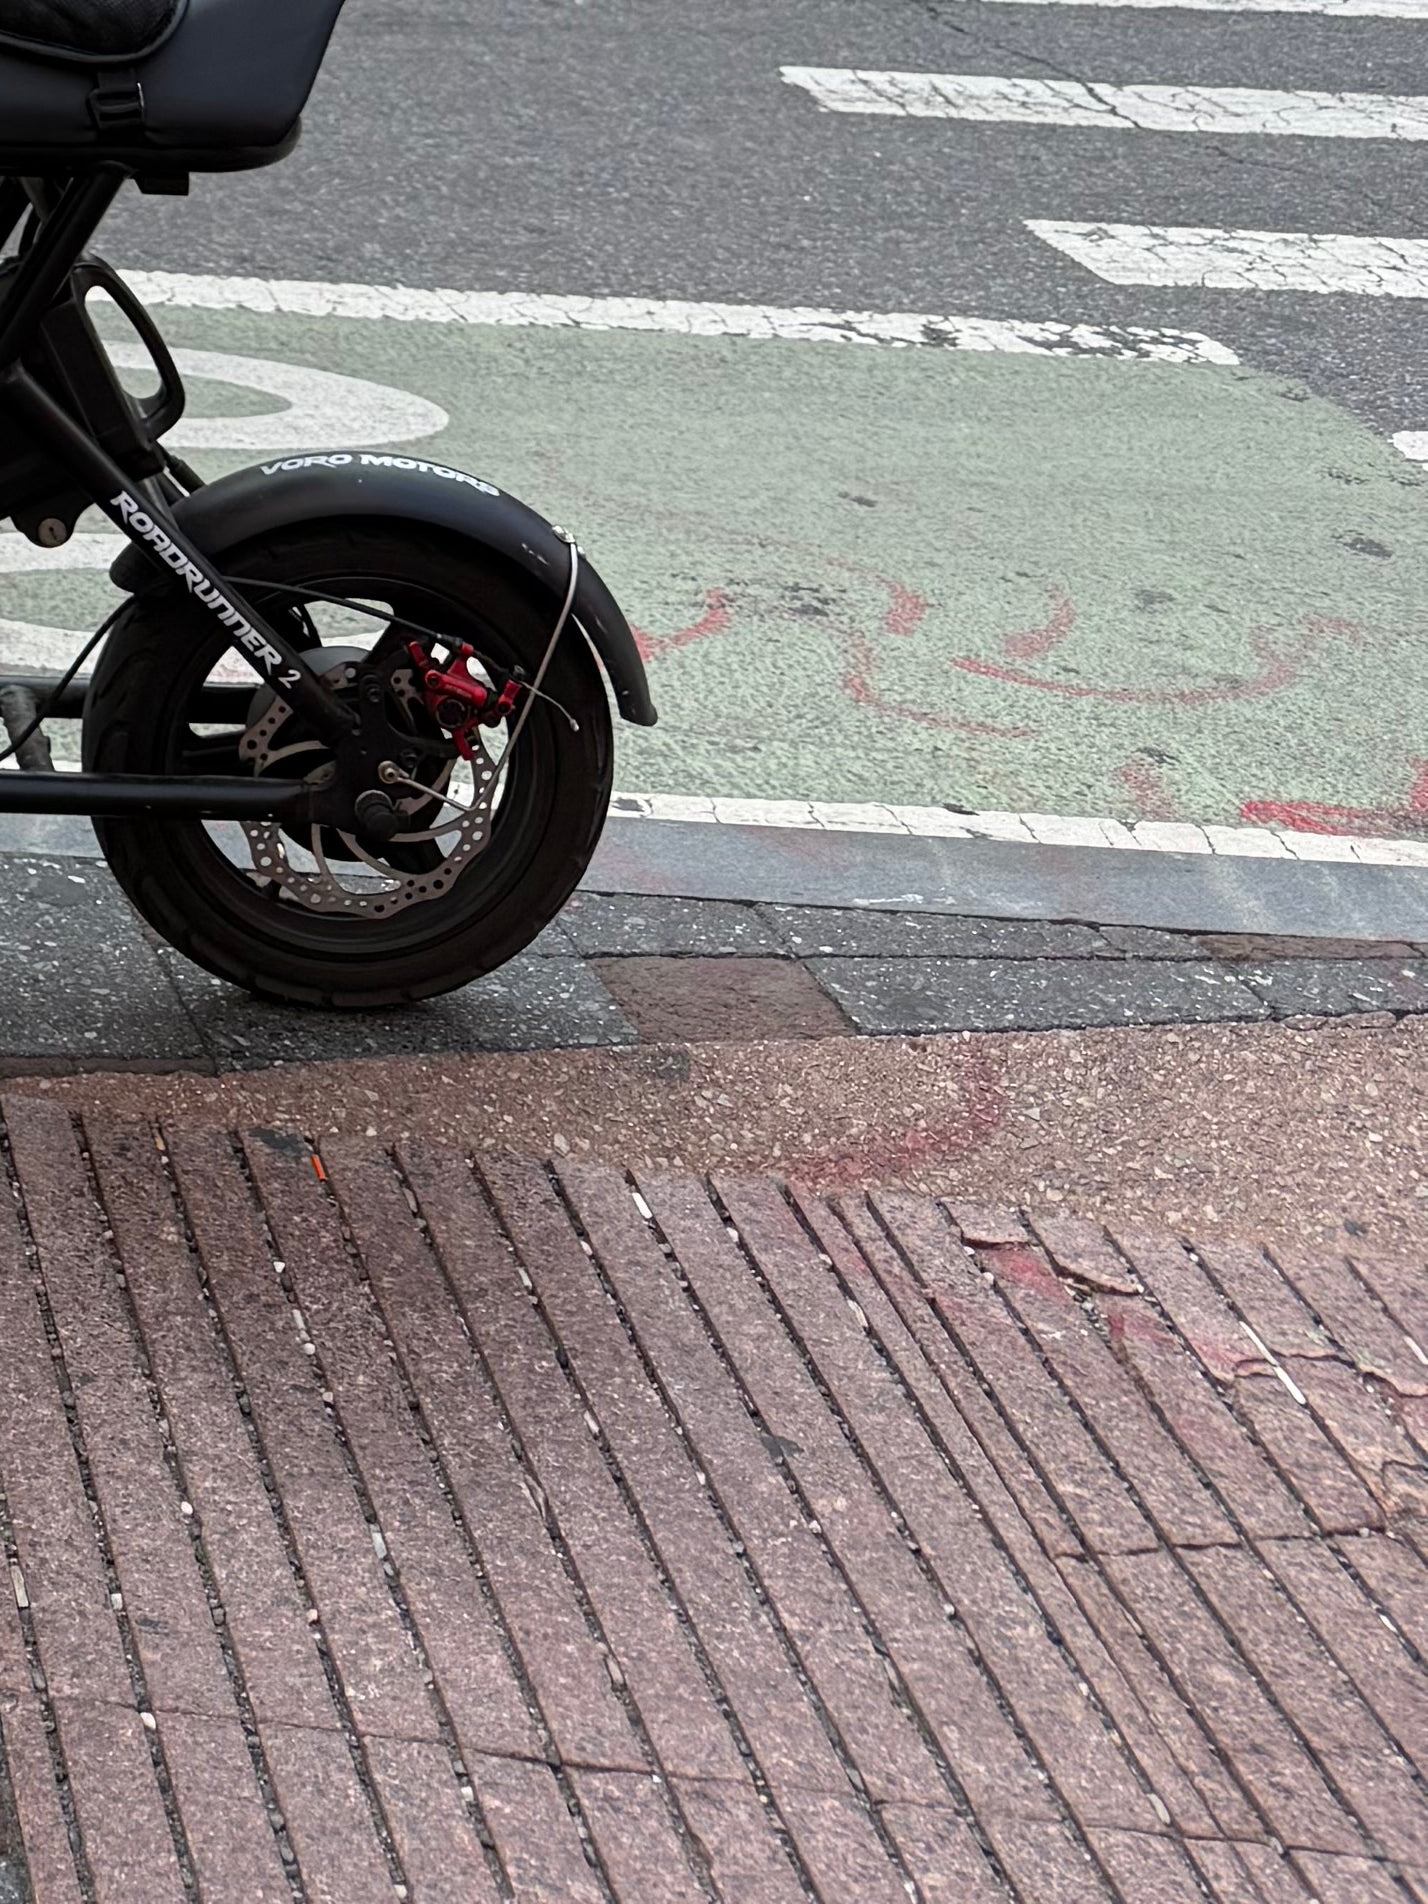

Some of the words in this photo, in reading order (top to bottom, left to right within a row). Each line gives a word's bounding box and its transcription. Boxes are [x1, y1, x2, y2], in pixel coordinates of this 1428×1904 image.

[260, 454, 353, 476] VORO
[358, 453, 501, 498] MOTORS
[109, 491, 283, 676] ROADRUNNER
[277, 669, 302, 690] 2
